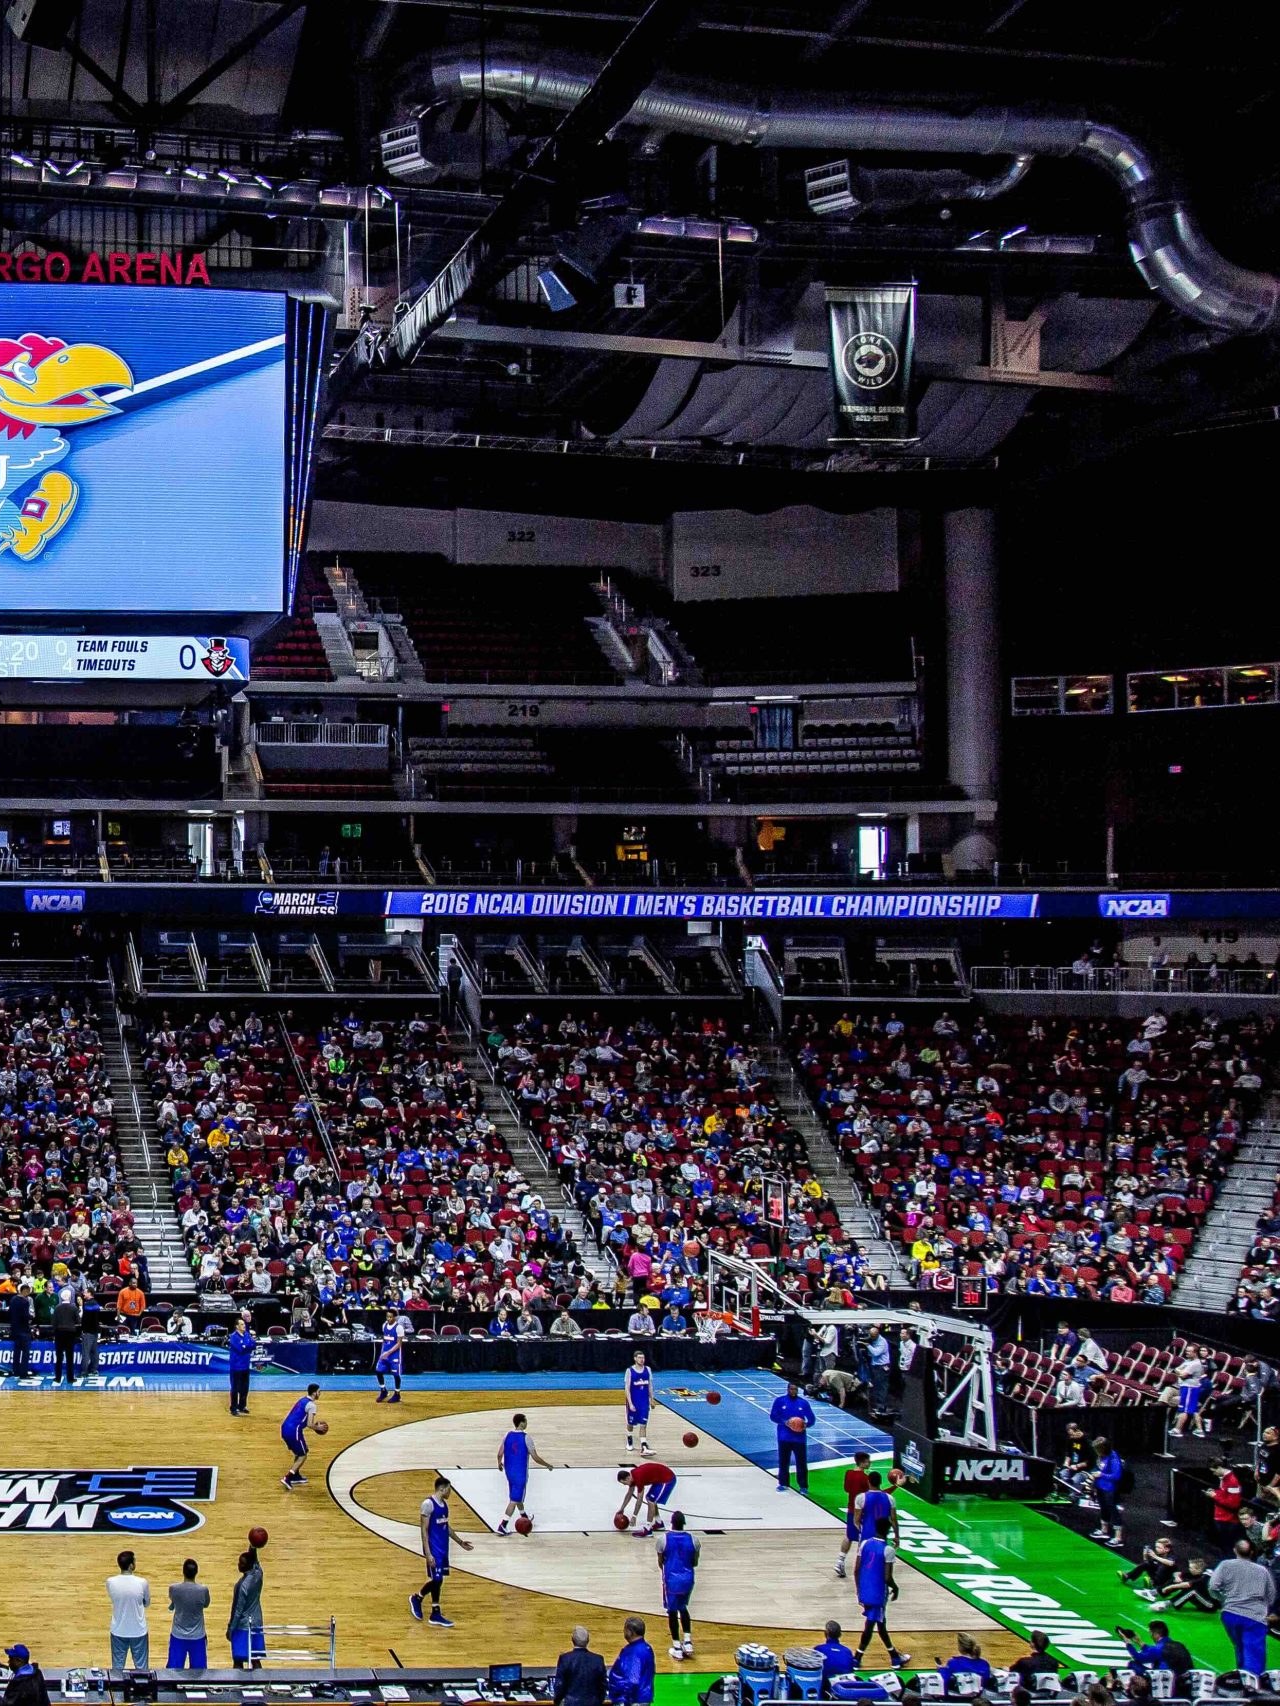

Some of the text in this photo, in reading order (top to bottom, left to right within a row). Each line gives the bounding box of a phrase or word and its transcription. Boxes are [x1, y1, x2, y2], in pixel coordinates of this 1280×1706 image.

[81, 252, 211, 286] ARENA
[857, 374, 883, 386] WILD
[507, 531, 536, 542] 322
[689, 565, 721, 578] 323
[76, 640, 109, 653] TEAM
[111, 640, 149, 653] FOULS
[179, 644, 196, 671] 0
[76, 659, 136, 672] TIMEOUTS
[508, 705, 540, 717] 219
[31, 894, 84, 912] NCAA
[273, 892, 316, 906] MARCH
[421, 893, 1002, 917] 2016 NCAA DIVISION I MEN'S BASKETBALL CHAMPIONSHIP
[1107, 898, 1168, 917] NCAA
[98, 1351, 136, 1365] STATE
[137, 1350, 214, 1366] UNIVERSITY
[952, 1459, 1024, 1481] NCAA
[109, 1511, 175, 1520] NCAA
[940, 1573, 1131, 1668] ROUND
